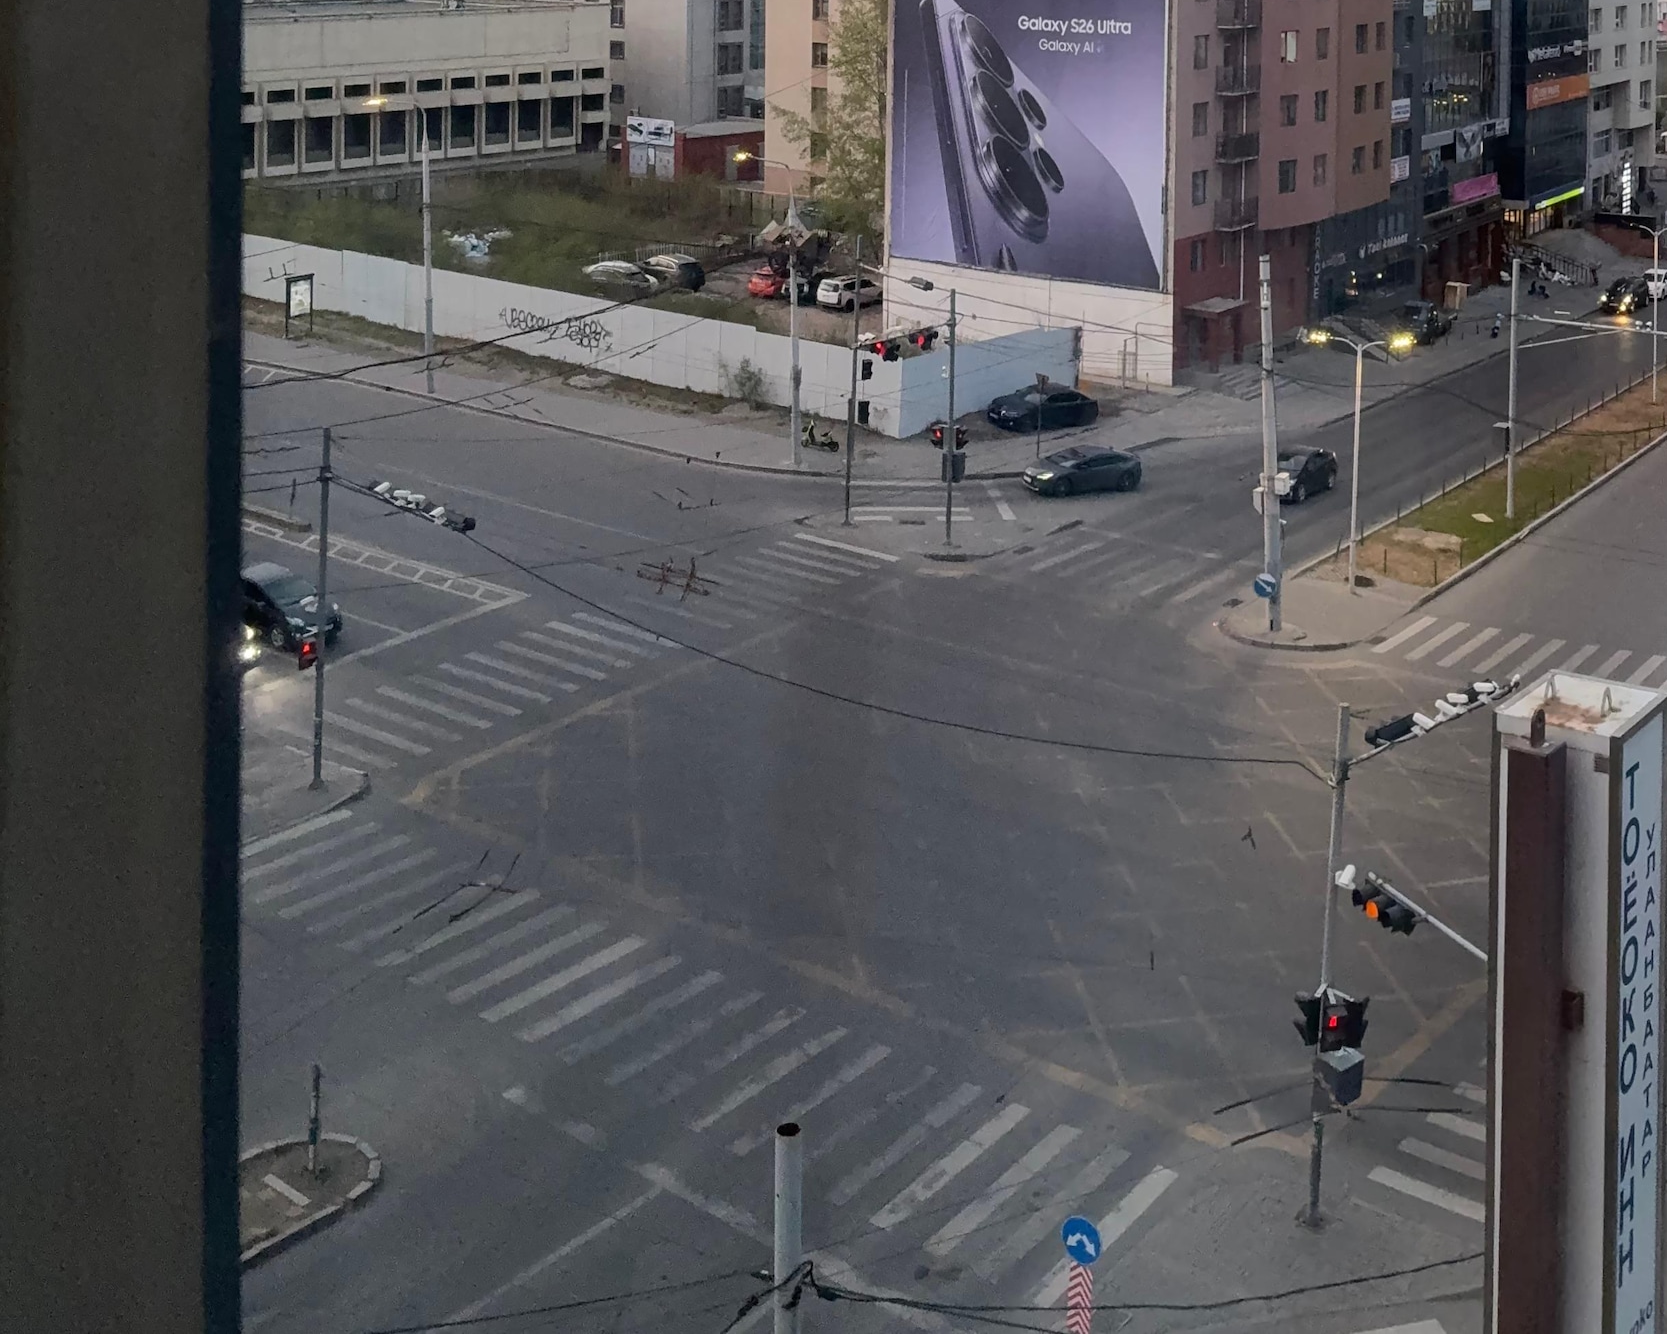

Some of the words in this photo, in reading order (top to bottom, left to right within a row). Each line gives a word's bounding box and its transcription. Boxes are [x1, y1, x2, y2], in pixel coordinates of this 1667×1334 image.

[1017, 15, 1068, 36] Galaxy
[1070, 19, 1095, 34] S26
[1097, 19, 1132, 35] Ultra
[1038, 38, 1081, 55] Galaxy
[1083, 41, 1094, 53] AI
[1620, 761, 1640, 1095] ТОЁОКО
[1641, 822, 1656, 1179] УЛААНБААТАР
[1618, 1122, 1635, 1289] ИНН
